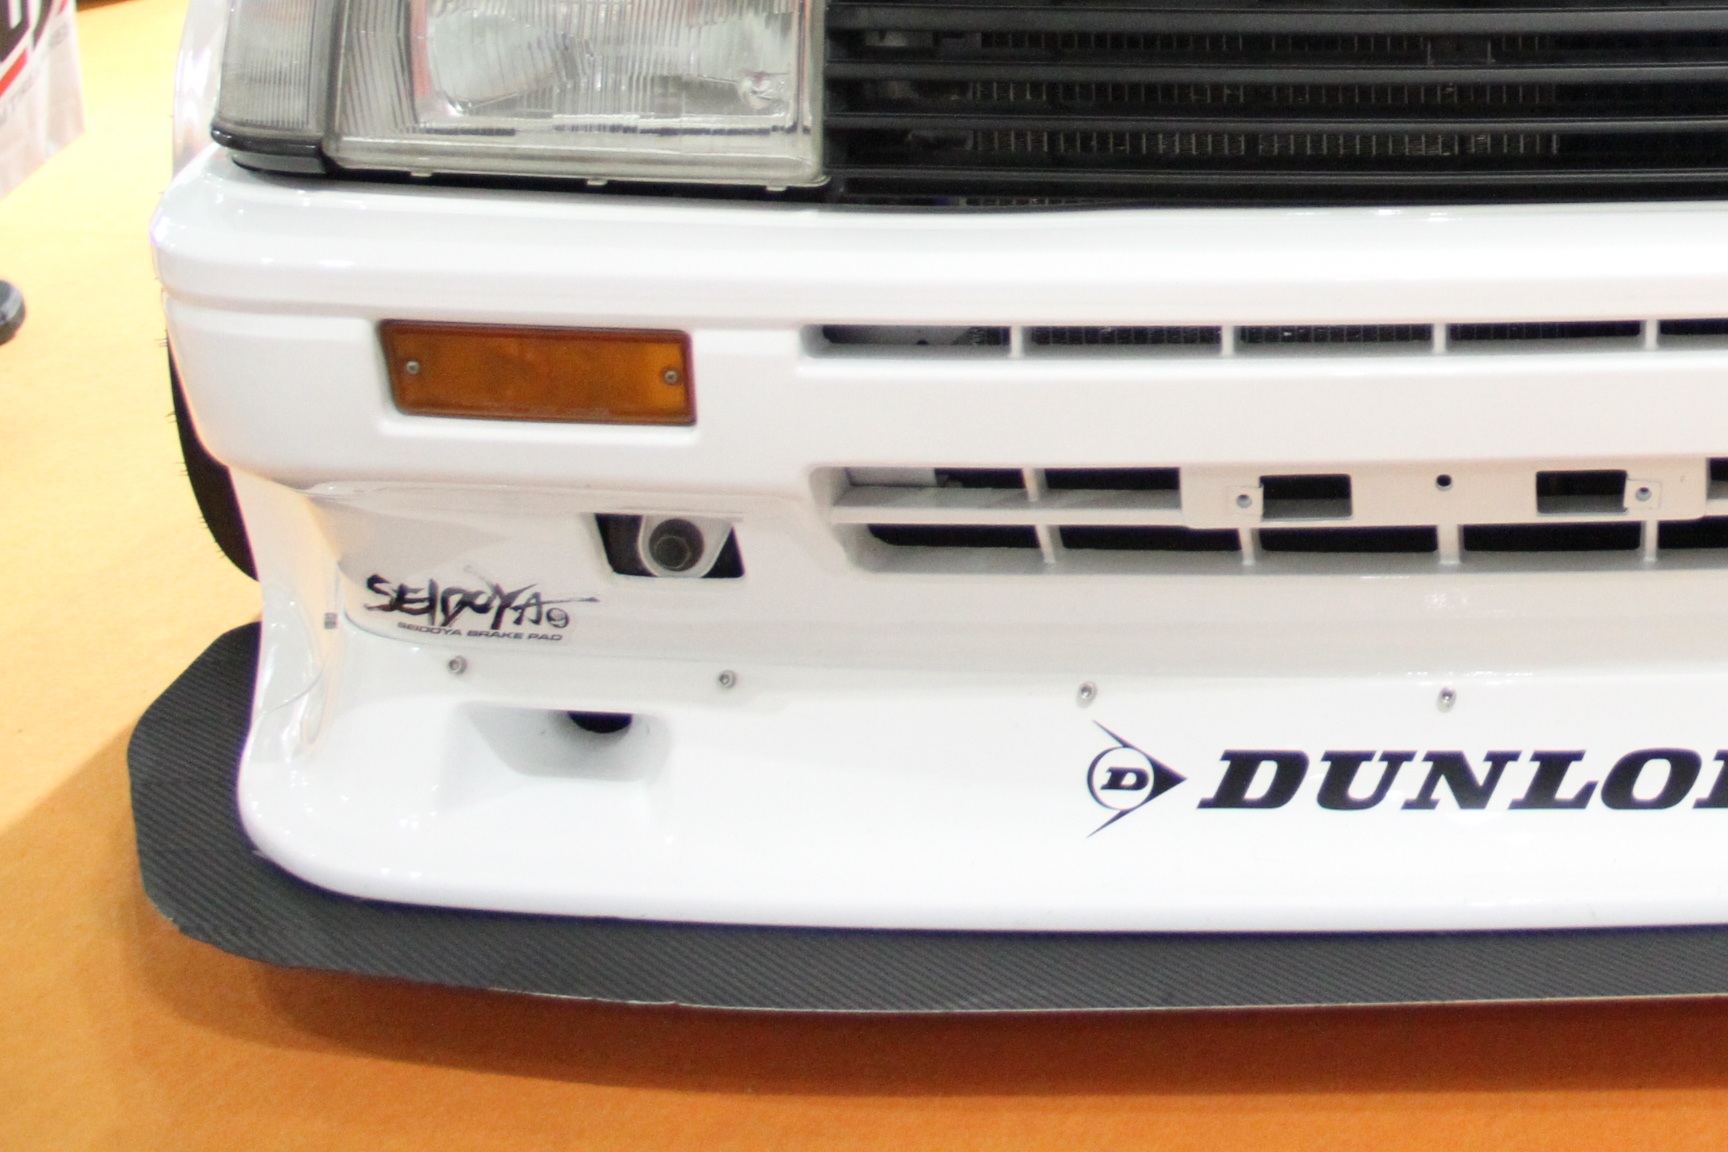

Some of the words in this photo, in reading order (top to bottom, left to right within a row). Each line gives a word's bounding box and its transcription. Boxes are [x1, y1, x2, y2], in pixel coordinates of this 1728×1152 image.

[364, 565, 600, 630] SEIDOYA
[397, 621, 462, 637] SEIDOYA
[467, 628, 524, 640] BRAKE
[528, 632, 563, 642] PAD
